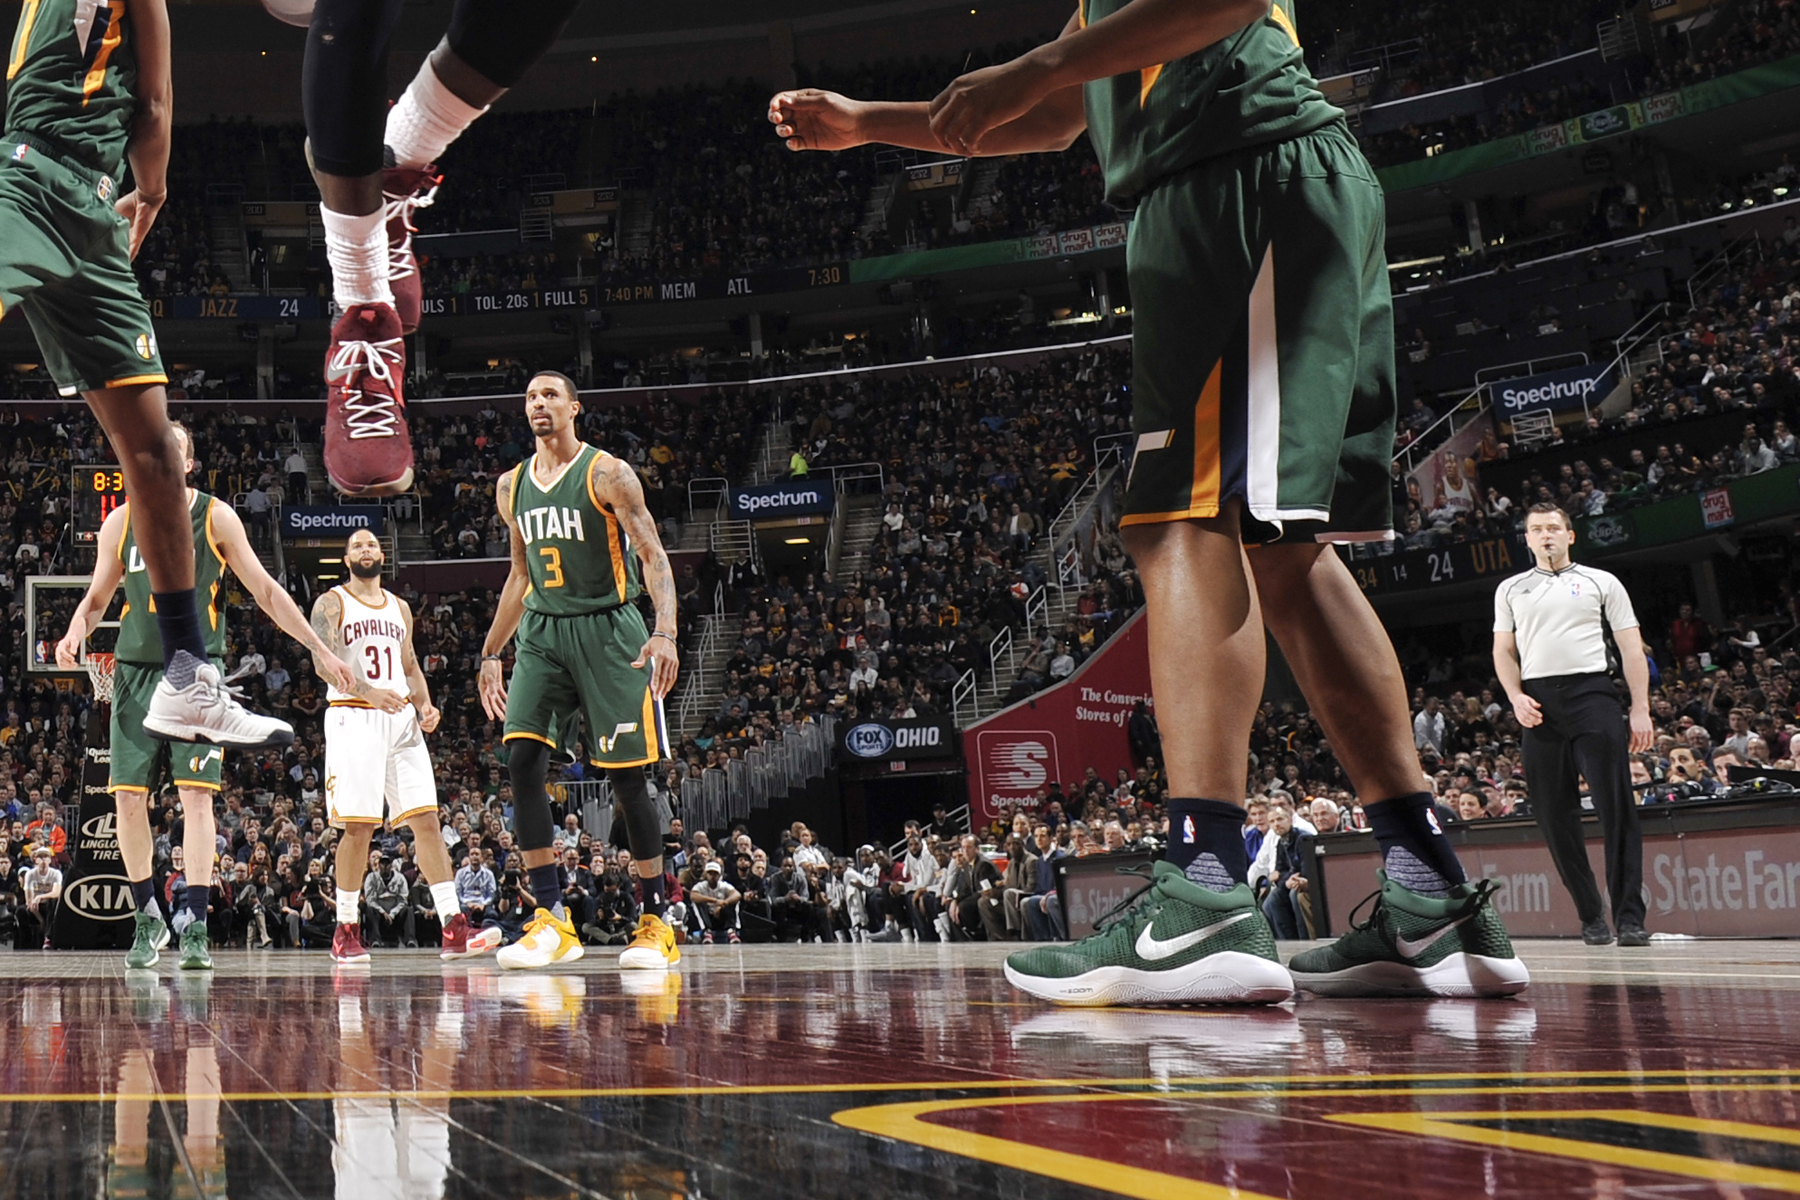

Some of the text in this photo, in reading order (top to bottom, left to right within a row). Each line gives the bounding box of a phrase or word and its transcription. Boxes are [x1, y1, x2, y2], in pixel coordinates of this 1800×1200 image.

[1061, 231, 1088, 245] drug
[1095, 224, 1121, 239] drug
[1099, 235, 1126, 247] mart
[1064, 241, 1094, 253] mart
[727, 267, 840, 296] ATL 7:30
[475, 296, 503, 311] TOL:
[506, 294, 529, 309] 20s
[545, 291, 576, 307] FULL
[580, 290, 588, 306] 5
[605, 283, 696, 303] 7:40 PM MEM
[199, 299, 238, 318] JAZZ
[280, 300, 300, 317] 24
[1503, 378, 1595, 410] Spectrum
[738, 491, 817, 512] Spectrum
[1703, 495, 1725, 508] drug
[290, 512, 369, 530] Spectrum
[517, 506, 585, 546] UTAH
[1708, 509, 1734, 523] mart
[540, 547, 565, 587] 3
[1393, 566, 1406, 580] 14
[1427, 552, 1454, 581] 24
[1471, 540, 1510, 573] UTA
[344, 619, 404, 646] CAVALIER
[365, 645, 392, 680] 31
[1081, 687, 1101, 701] The
[1076, 706, 1125, 727] Stores of
[857, 731, 881, 744] FOX
[895, 727, 940, 747] OHIO
[89, 747, 111, 756] Quic
[80, 840, 120, 849] LINGLO
[80, 884, 136, 910] KIA
